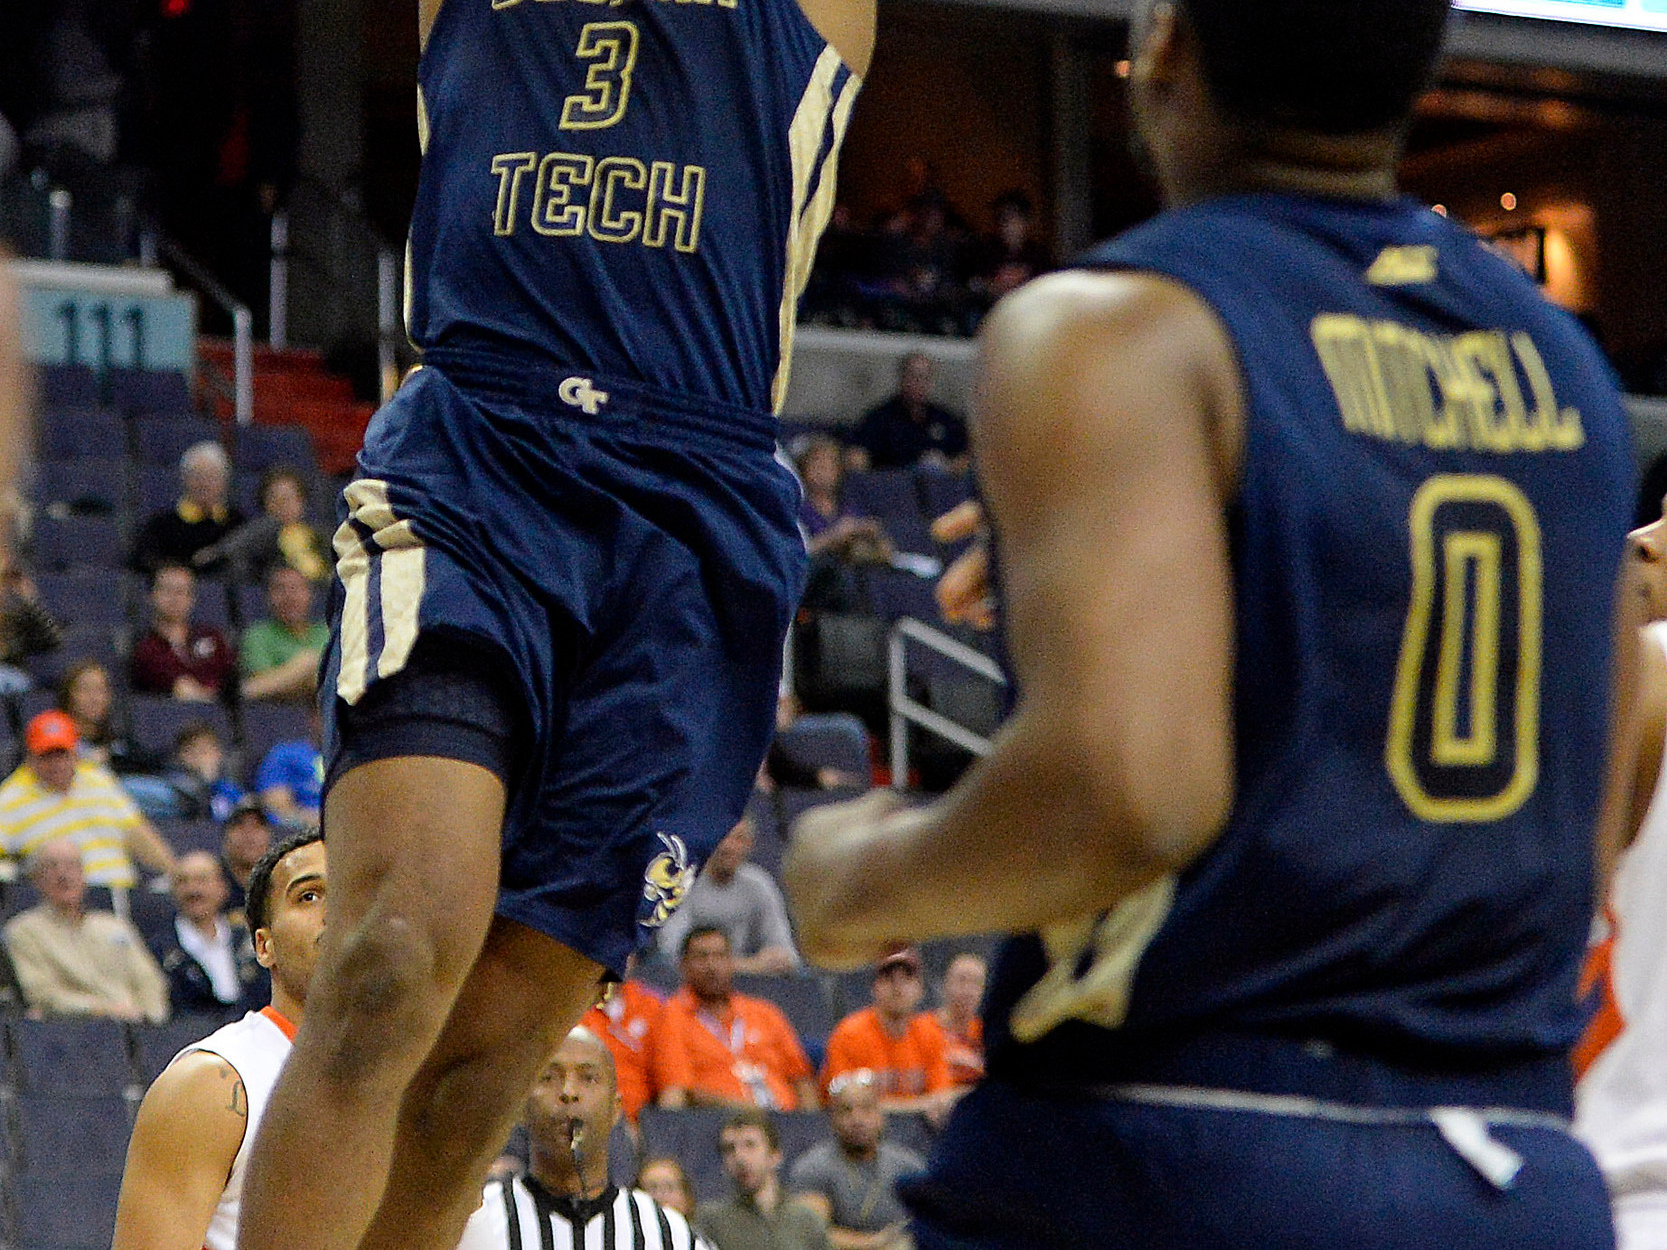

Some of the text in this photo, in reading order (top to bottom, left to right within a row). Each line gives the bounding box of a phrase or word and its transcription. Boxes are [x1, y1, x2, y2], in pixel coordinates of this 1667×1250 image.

[559, 21, 638, 130] 3
[490, 152, 706, 253] TECH
[57, 299, 146, 366] 111
[1386, 472, 1543, 823] 0
